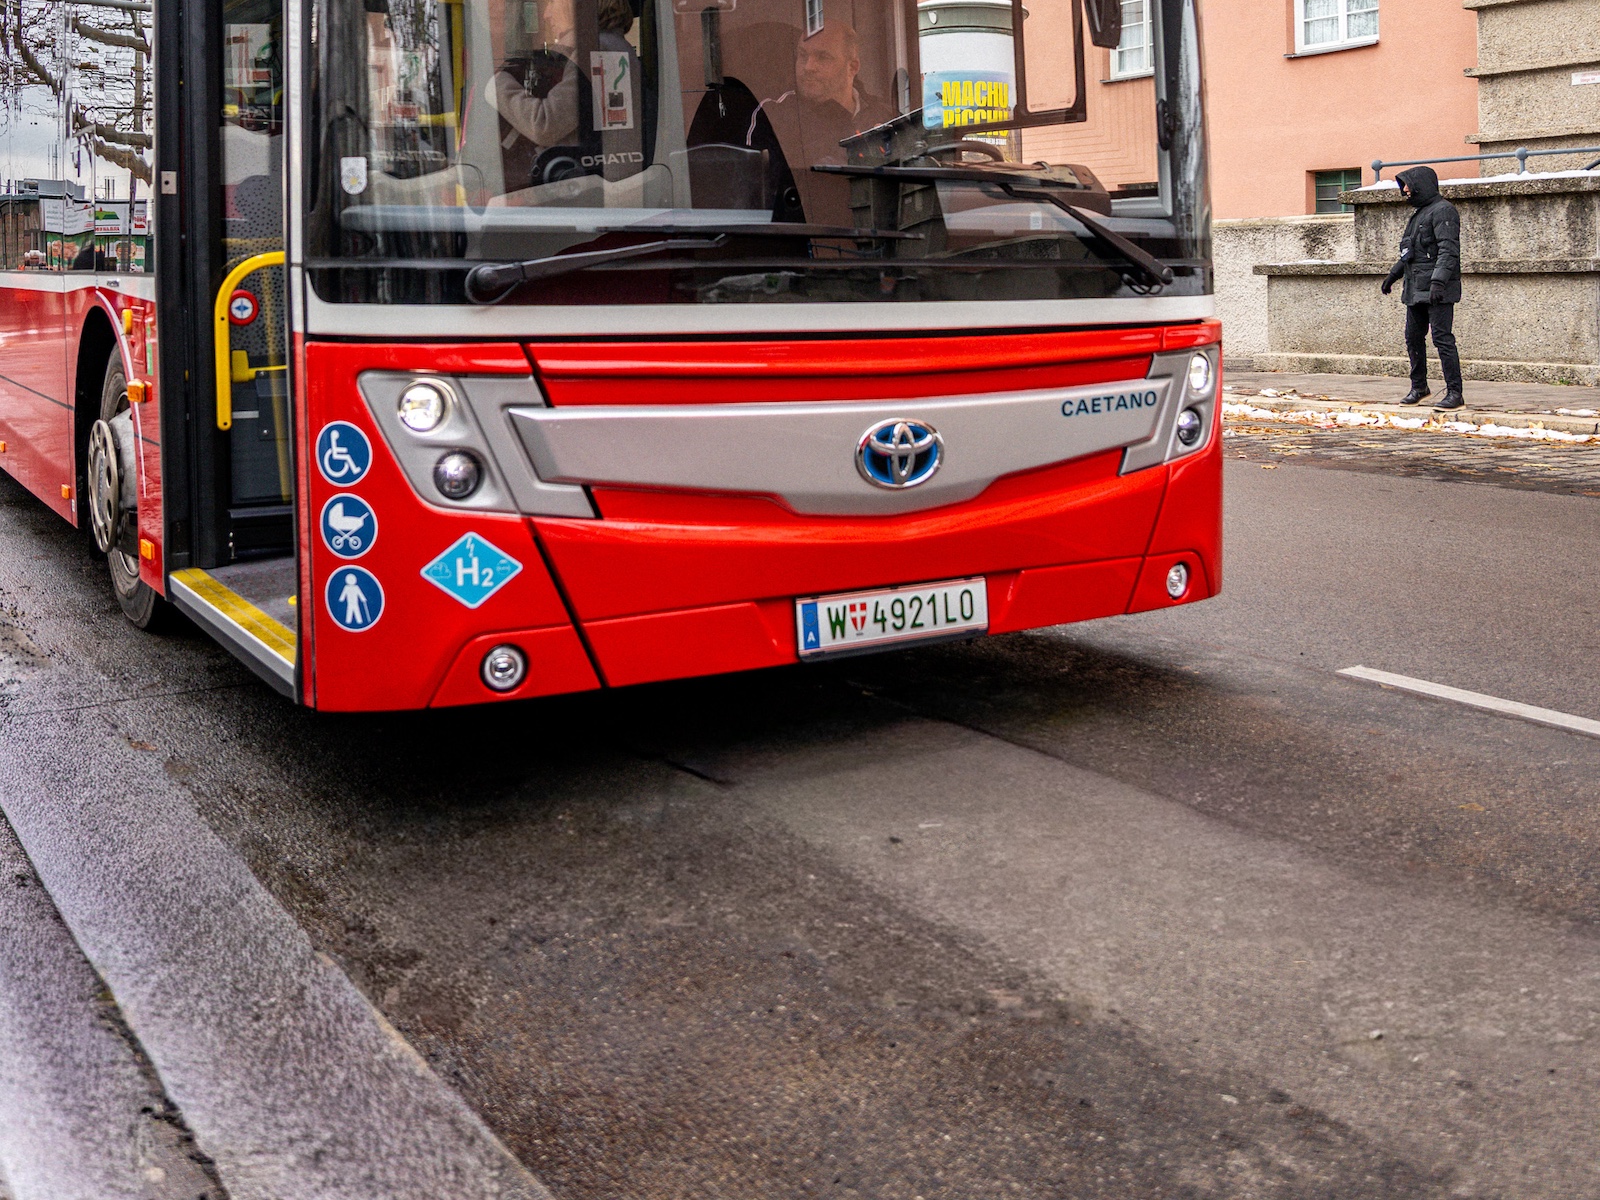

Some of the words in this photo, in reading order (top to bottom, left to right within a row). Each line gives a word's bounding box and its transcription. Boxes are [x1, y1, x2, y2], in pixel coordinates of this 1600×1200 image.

[942, 80, 1009, 109] MACHU
[1061, 390, 1157, 417] CAETANO
[807, 631, 816, 643] A
